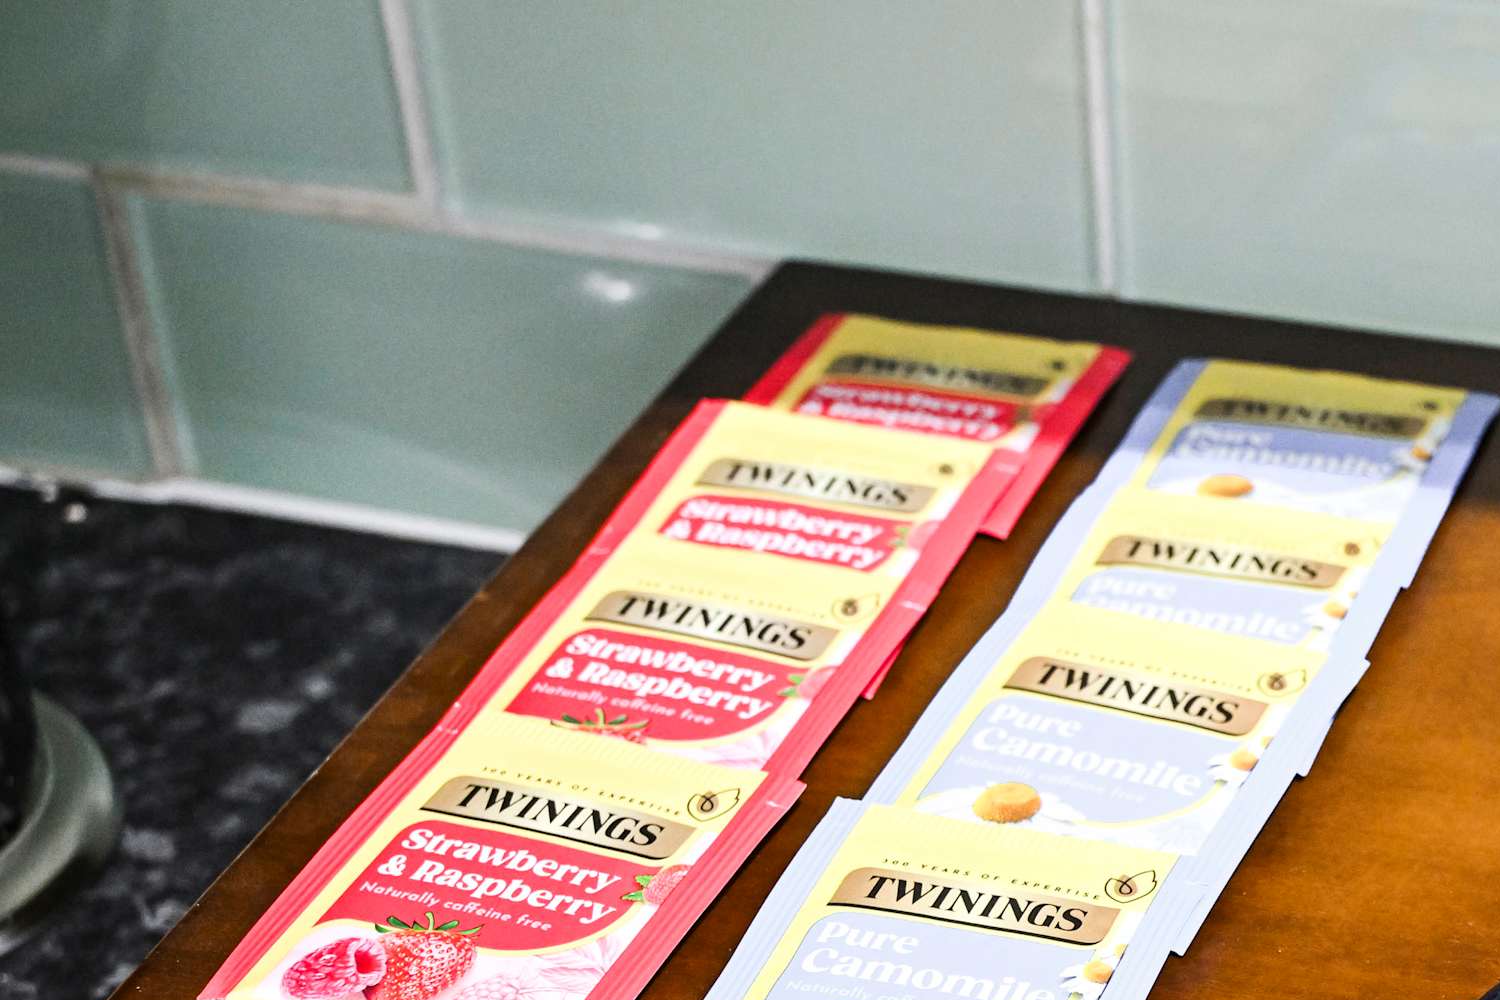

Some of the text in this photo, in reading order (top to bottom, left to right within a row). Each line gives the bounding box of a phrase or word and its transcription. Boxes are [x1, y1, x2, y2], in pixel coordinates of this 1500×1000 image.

[726, 463, 909, 504] TWININGS
[664, 519, 884, 570] & Raspberry
[680, 499, 884, 545] Strawberry
[1126, 540, 1320, 580] TWININGS
[616, 595, 813, 651] TWININGS
[545, 657, 774, 720] & Raspberry
[565, 633, 776, 692] Strawberry
[531, 681, 608, 706] Naturally
[680, 703, 716, 726] free
[988, 704, 1083, 738] Pure
[1036, 663, 1240, 725] TWININGS
[971, 726, 1203, 796] Camomile
[456, 783, 665, 848] TWININGS
[401, 828, 622, 895] Strawberry
[921, 863, 971, 877] YEARS
[981, 873, 1001, 882] OF
[1010, 878, 1102, 901] EXPERTISE
[359, 880, 553, 933] Naturally caffeine free
[377, 854, 617, 925] & Raspberry
[863, 874, 1089, 932] TWININGS
[815, 921, 921, 955] Pure
